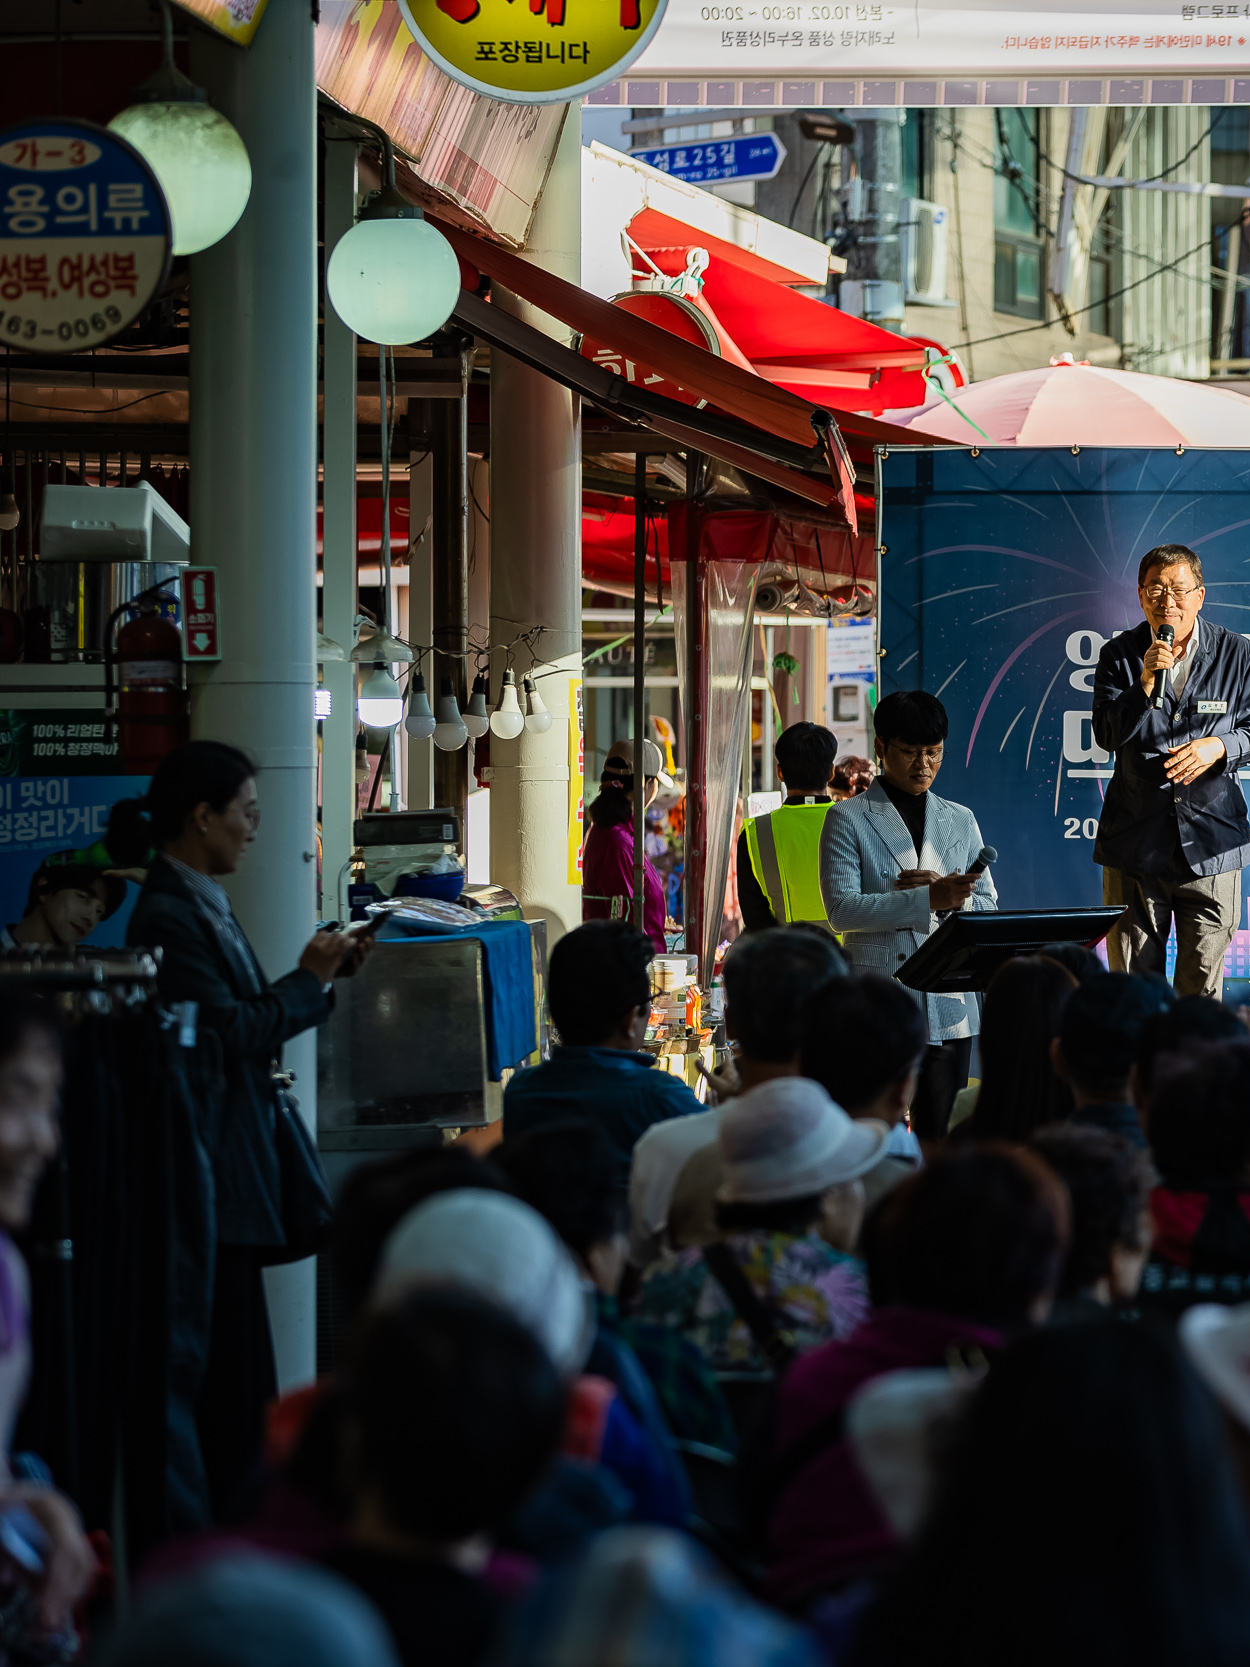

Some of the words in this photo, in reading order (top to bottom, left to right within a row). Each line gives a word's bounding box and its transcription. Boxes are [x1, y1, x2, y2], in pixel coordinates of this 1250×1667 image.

[474, 40, 590, 64] 포장됩니다
[3, 182, 150, 234] 용의류
[0, 305, 122, 342] 63-0069
[33, 724, 65, 738] 100%
[33, 743, 66, 756] 100%
[20, 778, 69, 808] 맛이
